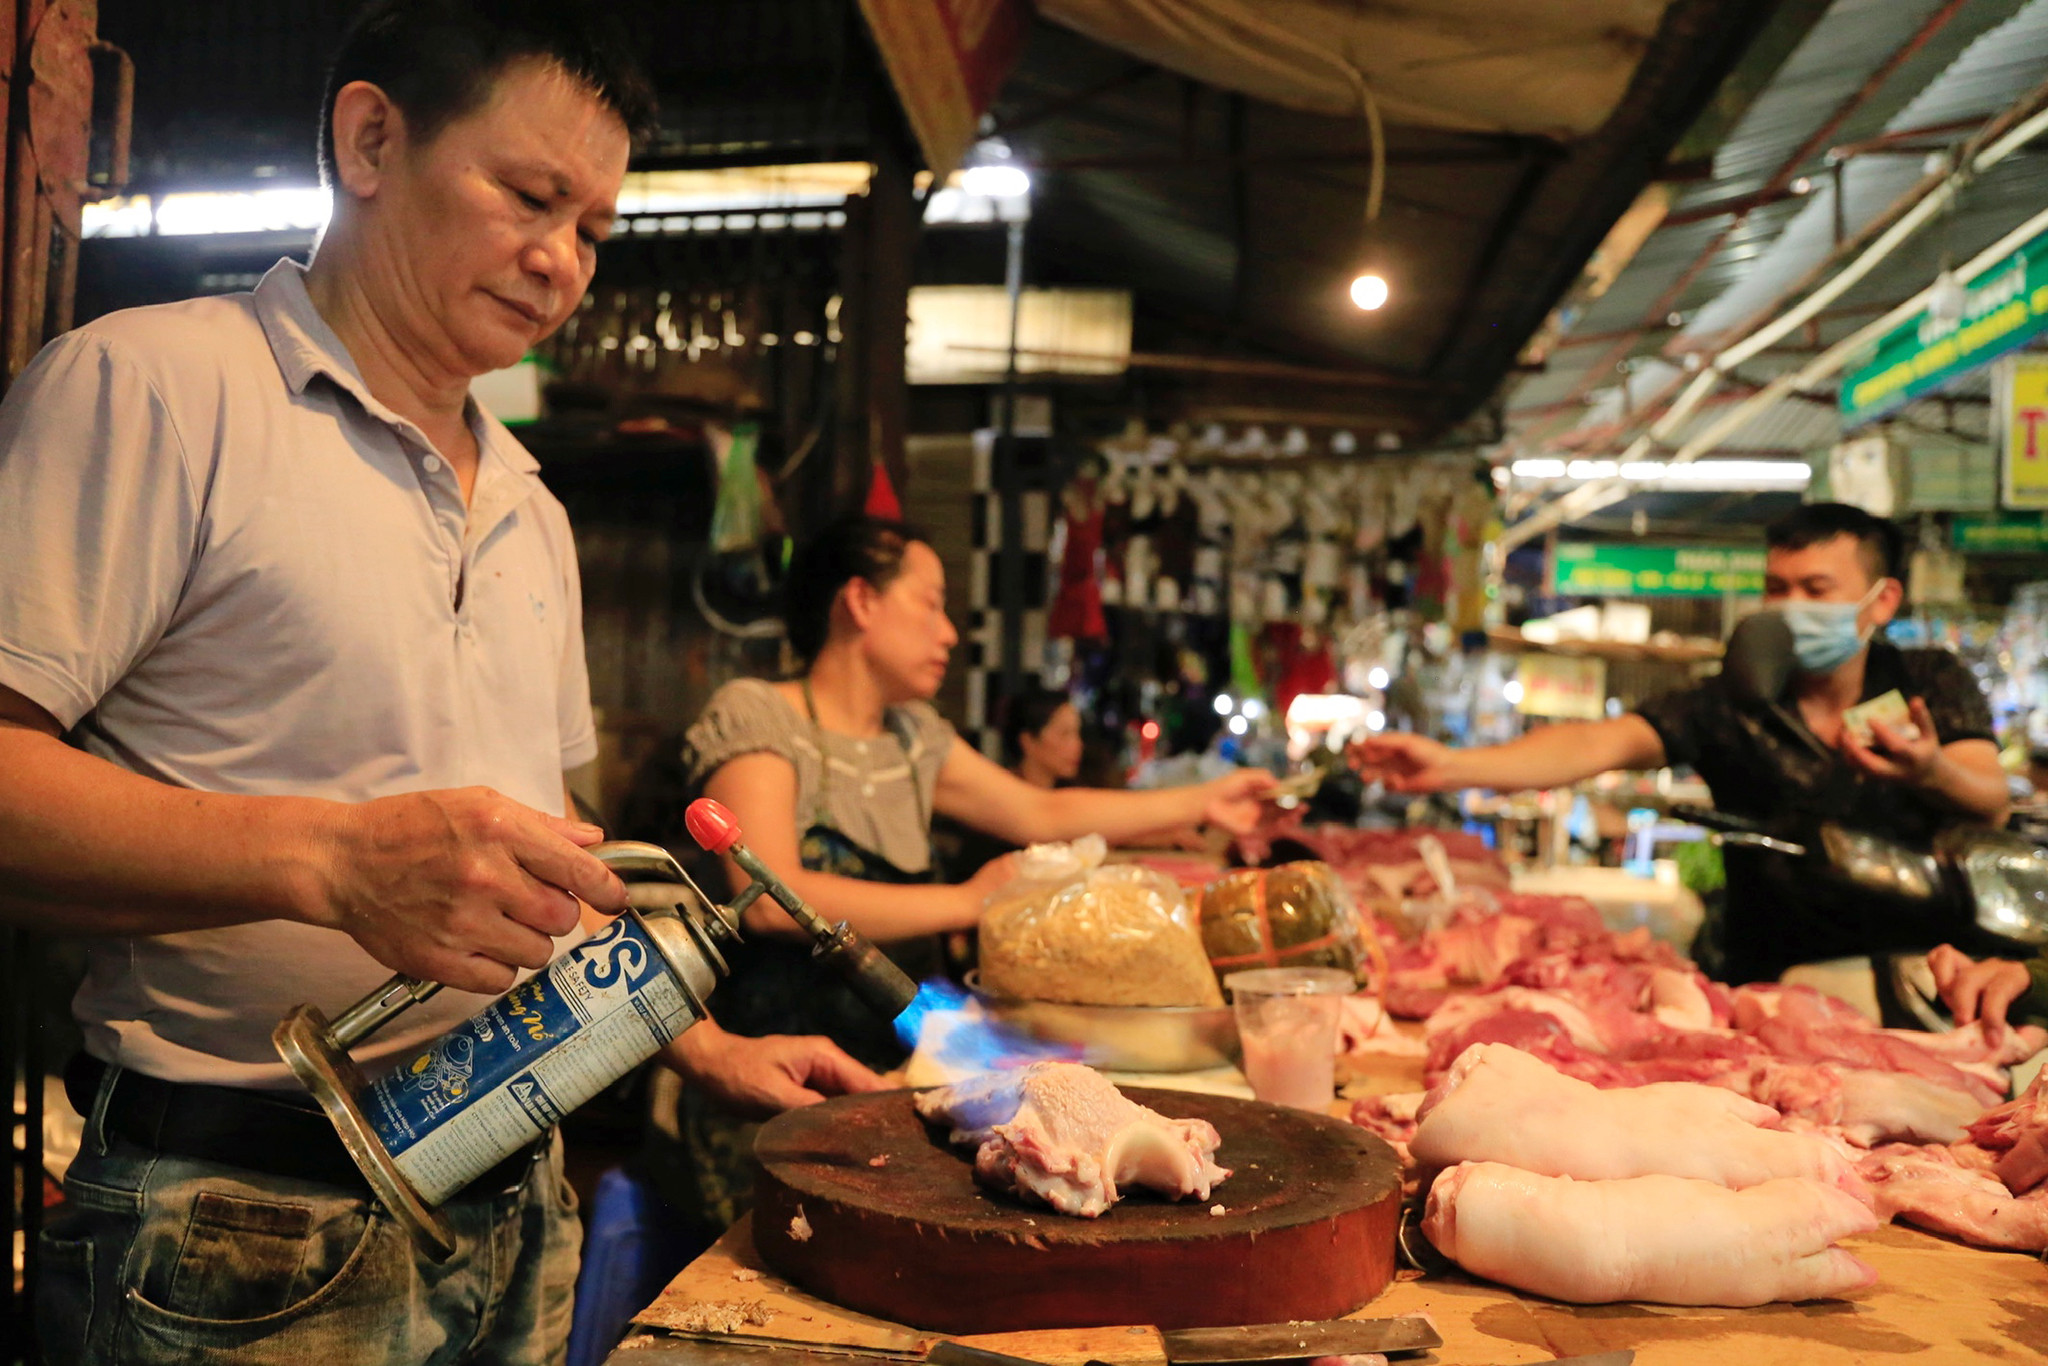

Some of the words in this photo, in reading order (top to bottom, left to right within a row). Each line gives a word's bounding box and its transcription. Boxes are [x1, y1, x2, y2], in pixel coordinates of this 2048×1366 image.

[570, 920, 648, 993] 2S
[566, 969, 594, 1003] SAFETY
[500, 1023, 511, 1035] an
[506, 1031, 524, 1052] toàn
